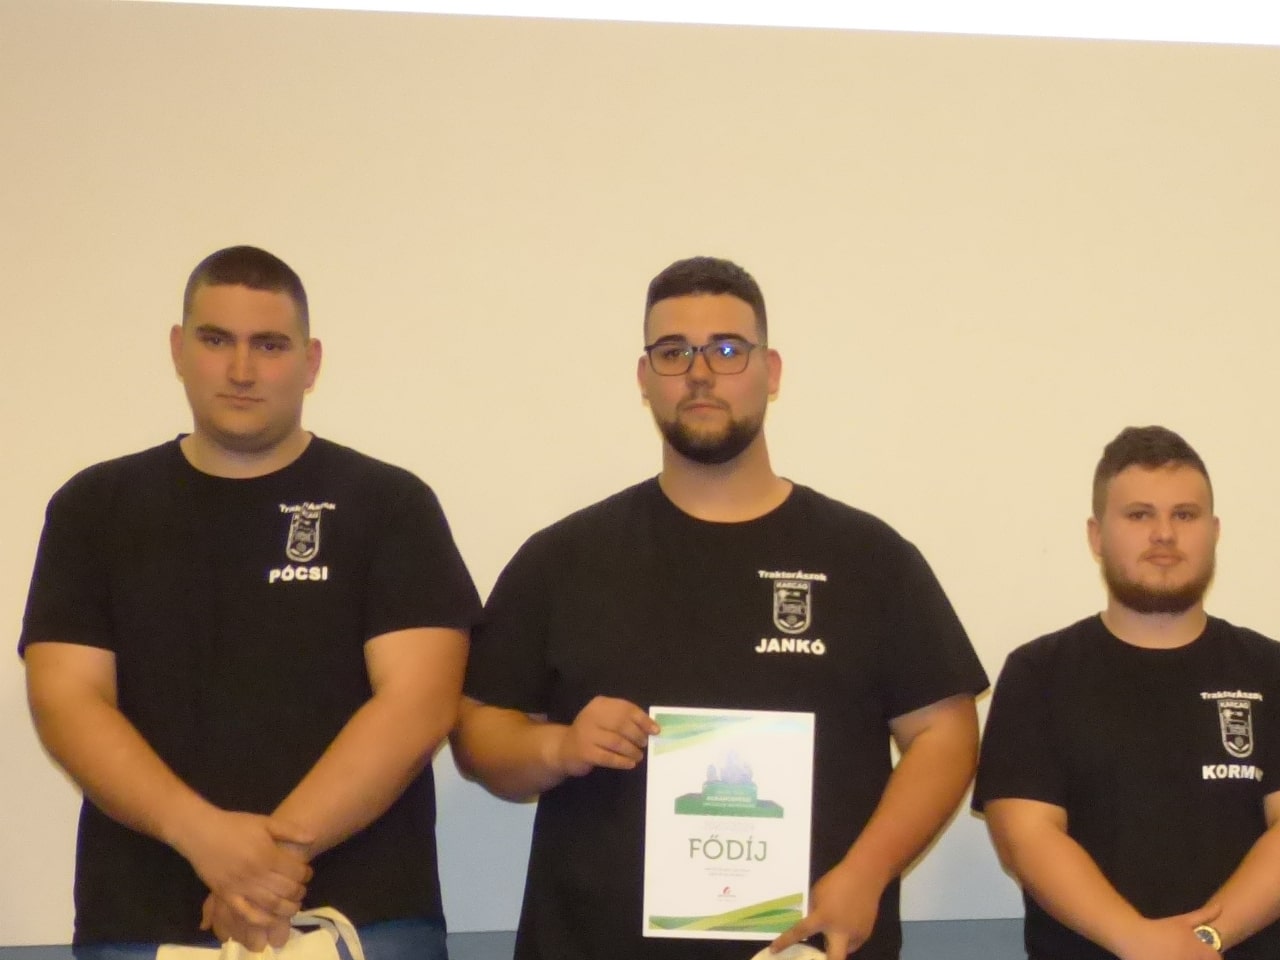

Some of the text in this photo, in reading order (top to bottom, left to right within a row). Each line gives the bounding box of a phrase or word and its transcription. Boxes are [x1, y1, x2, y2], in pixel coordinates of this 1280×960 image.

[269, 564, 328, 584] PÓCSI
[754, 637, 826, 656] JANKÓ
[688, 834, 768, 862] FŐDÍJ
